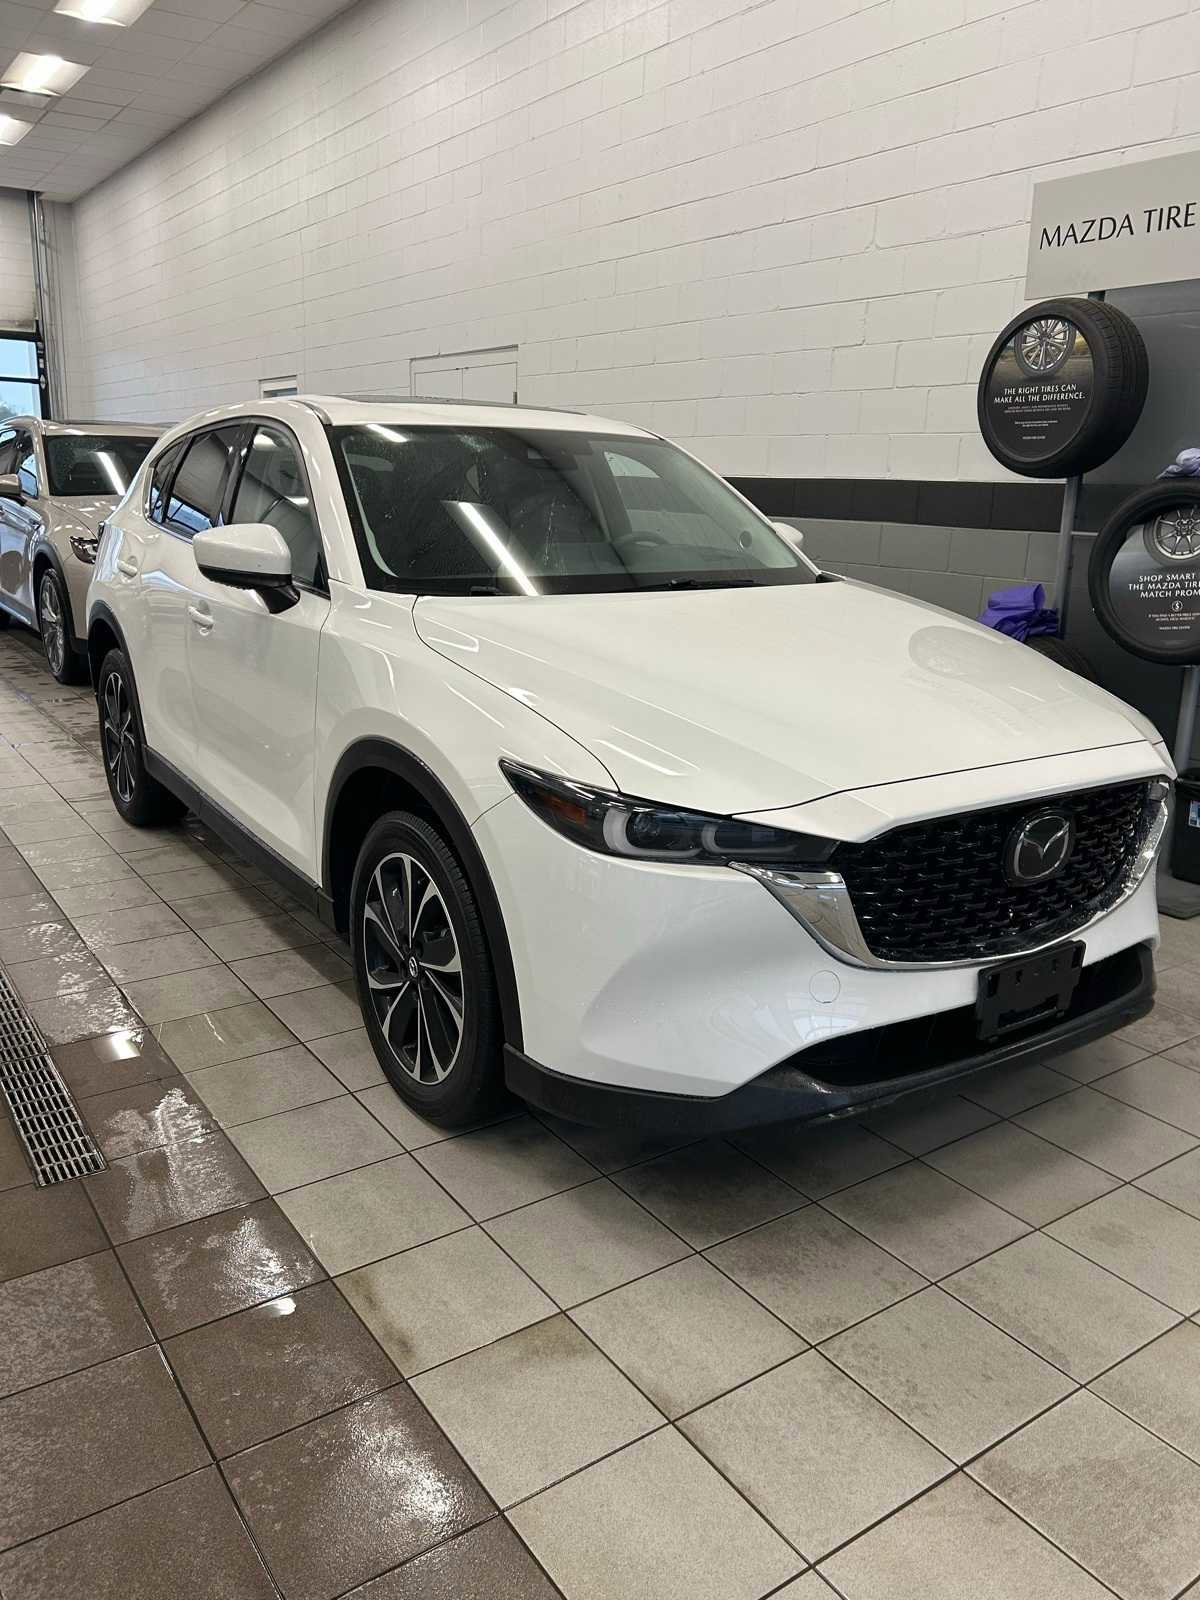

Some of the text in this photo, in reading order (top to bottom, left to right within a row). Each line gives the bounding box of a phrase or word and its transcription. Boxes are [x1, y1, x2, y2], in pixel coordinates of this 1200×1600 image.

[1039, 202, 1197, 250] MAZDA TIRE
[1018, 386, 1038, 394] RIGHT
[994, 396, 1012, 404] MAKE
[1014, 395, 1025, 403] ALL
[1042, 392, 1086, 401] DIFFERENCE.
[1166, 573, 1195, 581] SMART
[1128, 583, 1144, 591] THE
[1140, 590, 1172, 598] MATCH
